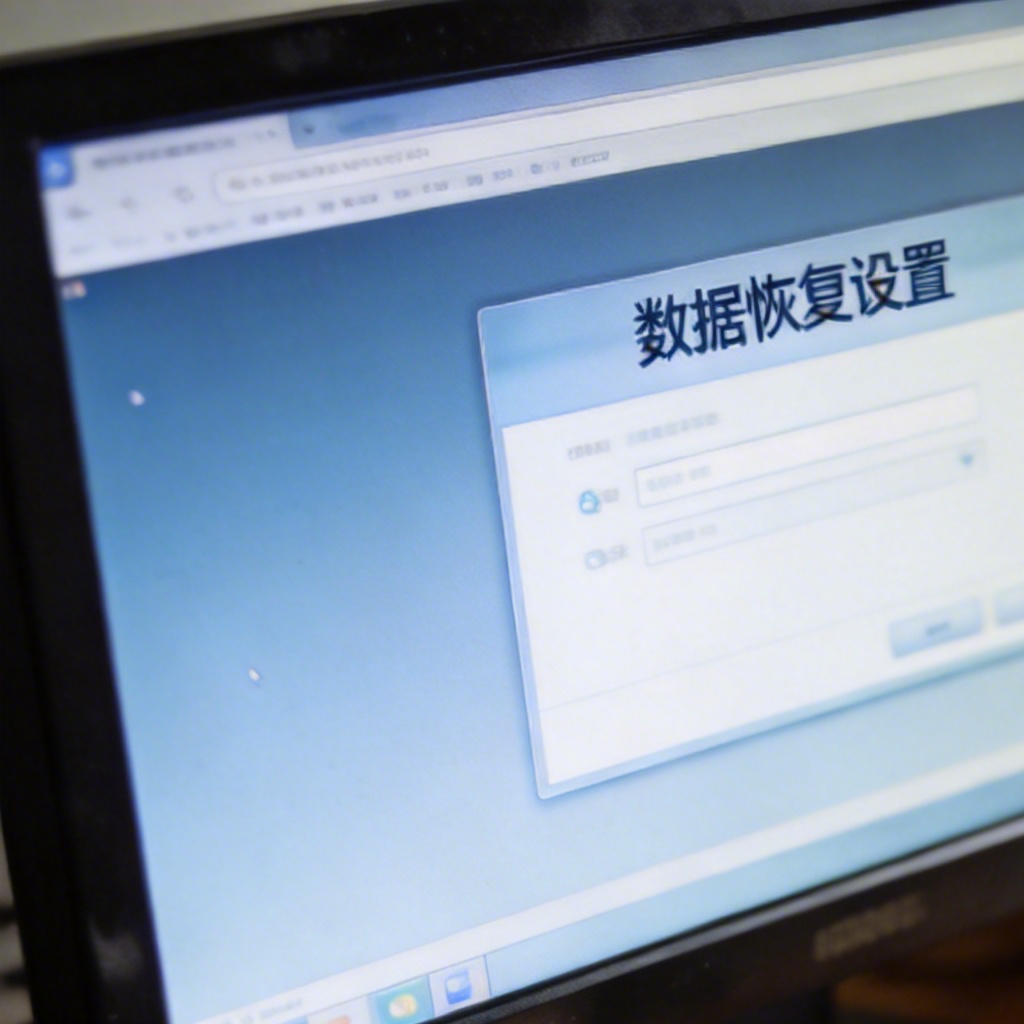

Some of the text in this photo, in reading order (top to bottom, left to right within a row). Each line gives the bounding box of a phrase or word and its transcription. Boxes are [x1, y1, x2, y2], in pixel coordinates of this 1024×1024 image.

[633, 239, 955, 368] 数据恢复设置
